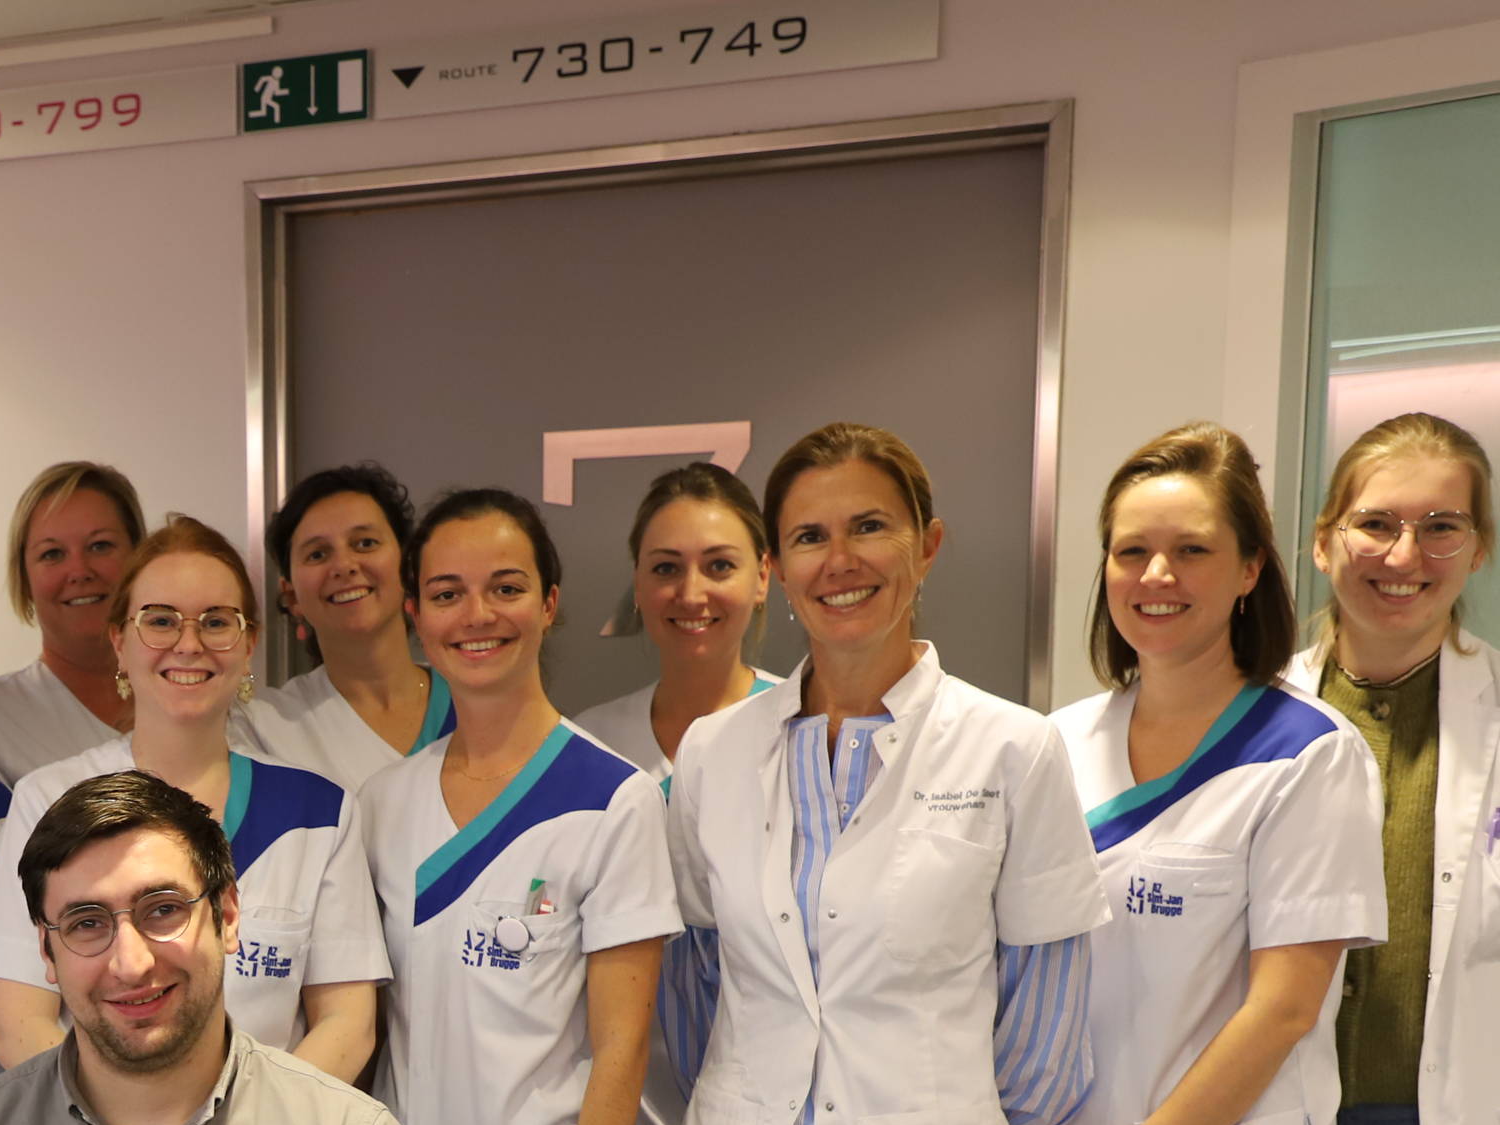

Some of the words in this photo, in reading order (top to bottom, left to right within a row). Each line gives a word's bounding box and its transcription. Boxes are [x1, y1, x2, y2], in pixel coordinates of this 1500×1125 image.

[439, 64, 498, 81] ROUTE
[512, 16, 808, 84] 730-749
[1151, 904, 1183, 917] Brugge
[490, 957, 521, 970] Brugge
